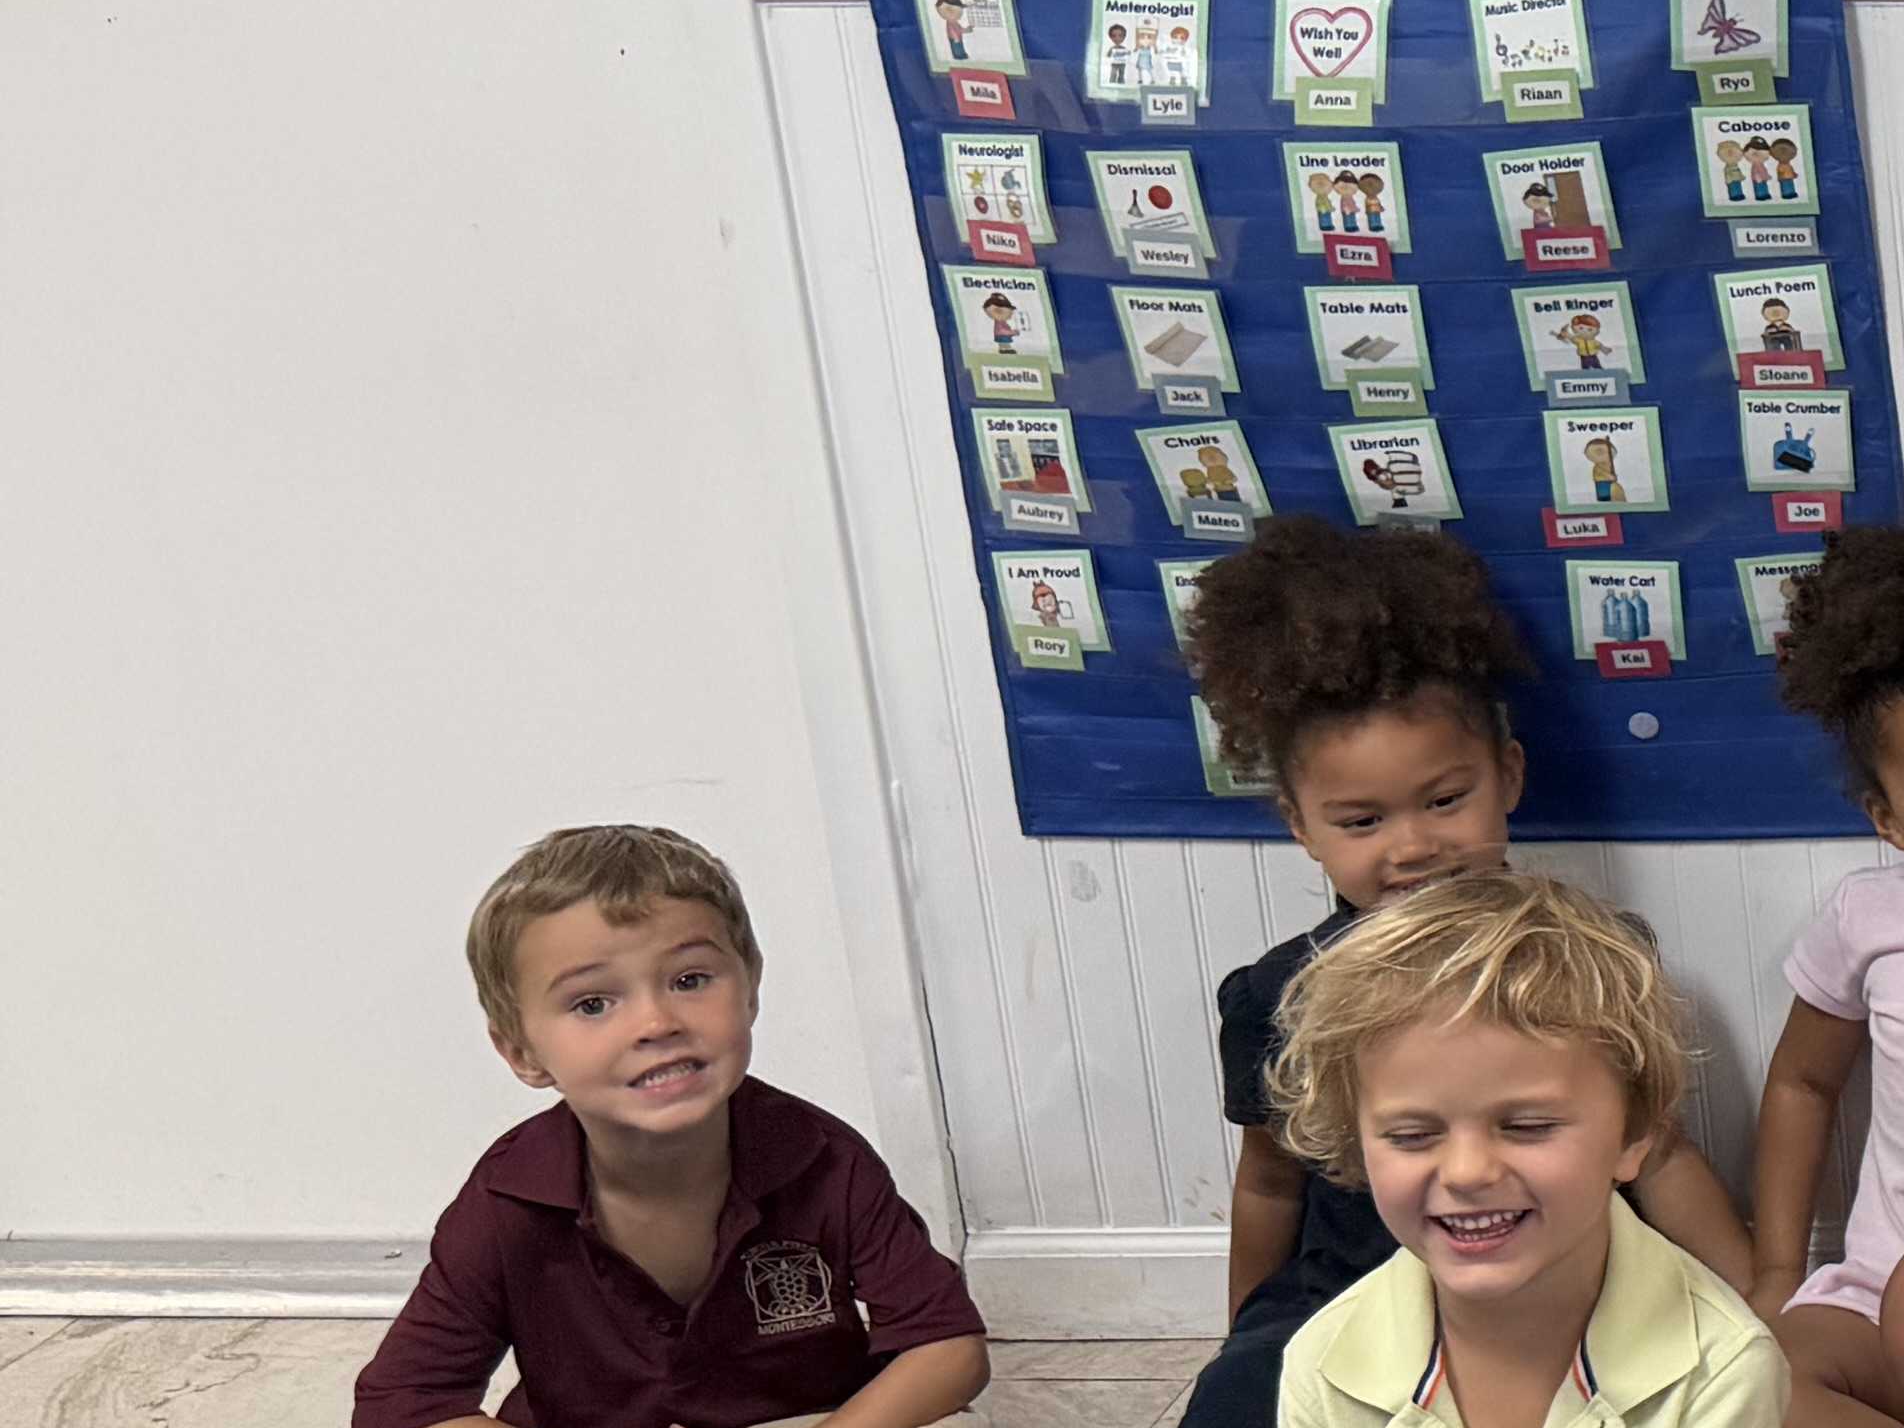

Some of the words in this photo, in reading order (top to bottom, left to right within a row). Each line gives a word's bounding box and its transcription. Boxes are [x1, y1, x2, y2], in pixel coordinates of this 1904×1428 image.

[1105, 0, 1195, 18] Meterologist
[1485, 1, 1518, 17] Music
[1300, 27, 1332, 41] Wish
[1335, 28, 1359, 41] You
[1312, 46, 1342, 59] Well
[1720, 76, 1750, 91] Ryo
[1152, 97, 1183, 114] Lyle
[1314, 92, 1352, 107] Anna
[1718, 119, 1791, 133] Caboose
[958, 144, 1025, 160] Neurologist
[1107, 163, 1177, 176] Dismissal
[1299, 155, 1330, 168] Line
[1333, 155, 1386, 169] Leader
[1501, 160, 1536, 175] Door
[1538, 156, 1585, 172] Holder
[1745, 231, 1806, 244] Lorenzo
[1140, 249, 1189, 264] Wesley
[1339, 248, 1373, 262] Ezra
[1541, 243, 1589, 257] Reese
[962, 277, 1036, 291] Electrician
[1729, 283, 1772, 298] Lunch
[1775, 279, 1816, 294] Poem
[1128, 298, 1166, 312] Floor
[1168, 300, 1203, 314] Mats
[1319, 301, 1366, 314] Table
[1370, 301, 1409, 314] Mats
[1533, 300, 1561, 314] Bell
[1565, 297, 1614, 314] Ringer
[1759, 368, 1808, 382] Sloane
[1171, 389, 1204, 403] Jack
[1366, 385, 1410, 402] Henry
[1561, 381, 1608, 396] Emmy
[1746, 401, 1781, 415] Table
[1784, 401, 1842, 416] Crumber
[987, 419, 1014, 433] Safe
[1017, 420, 1058, 435] Space
[1567, 419, 1634, 435] Sweeper
[1164, 432, 1221, 448] Chairs
[1350, 435, 1420, 451] Librarian
[1016, 504, 1065, 522] Aubrey
[1794, 505, 1820, 518] Joe
[1198, 515, 1240, 529] Mateo
[1563, 521, 1600, 535] Luka
[1008, 567, 1013, 579] I
[1016, 567, 1040, 579] Am
[1043, 567, 1081, 580] Proud
[1589, 575, 1625, 588] Water
[1627, 575, 1657, 588] Cart
[1033, 639, 1066, 655] Rory
